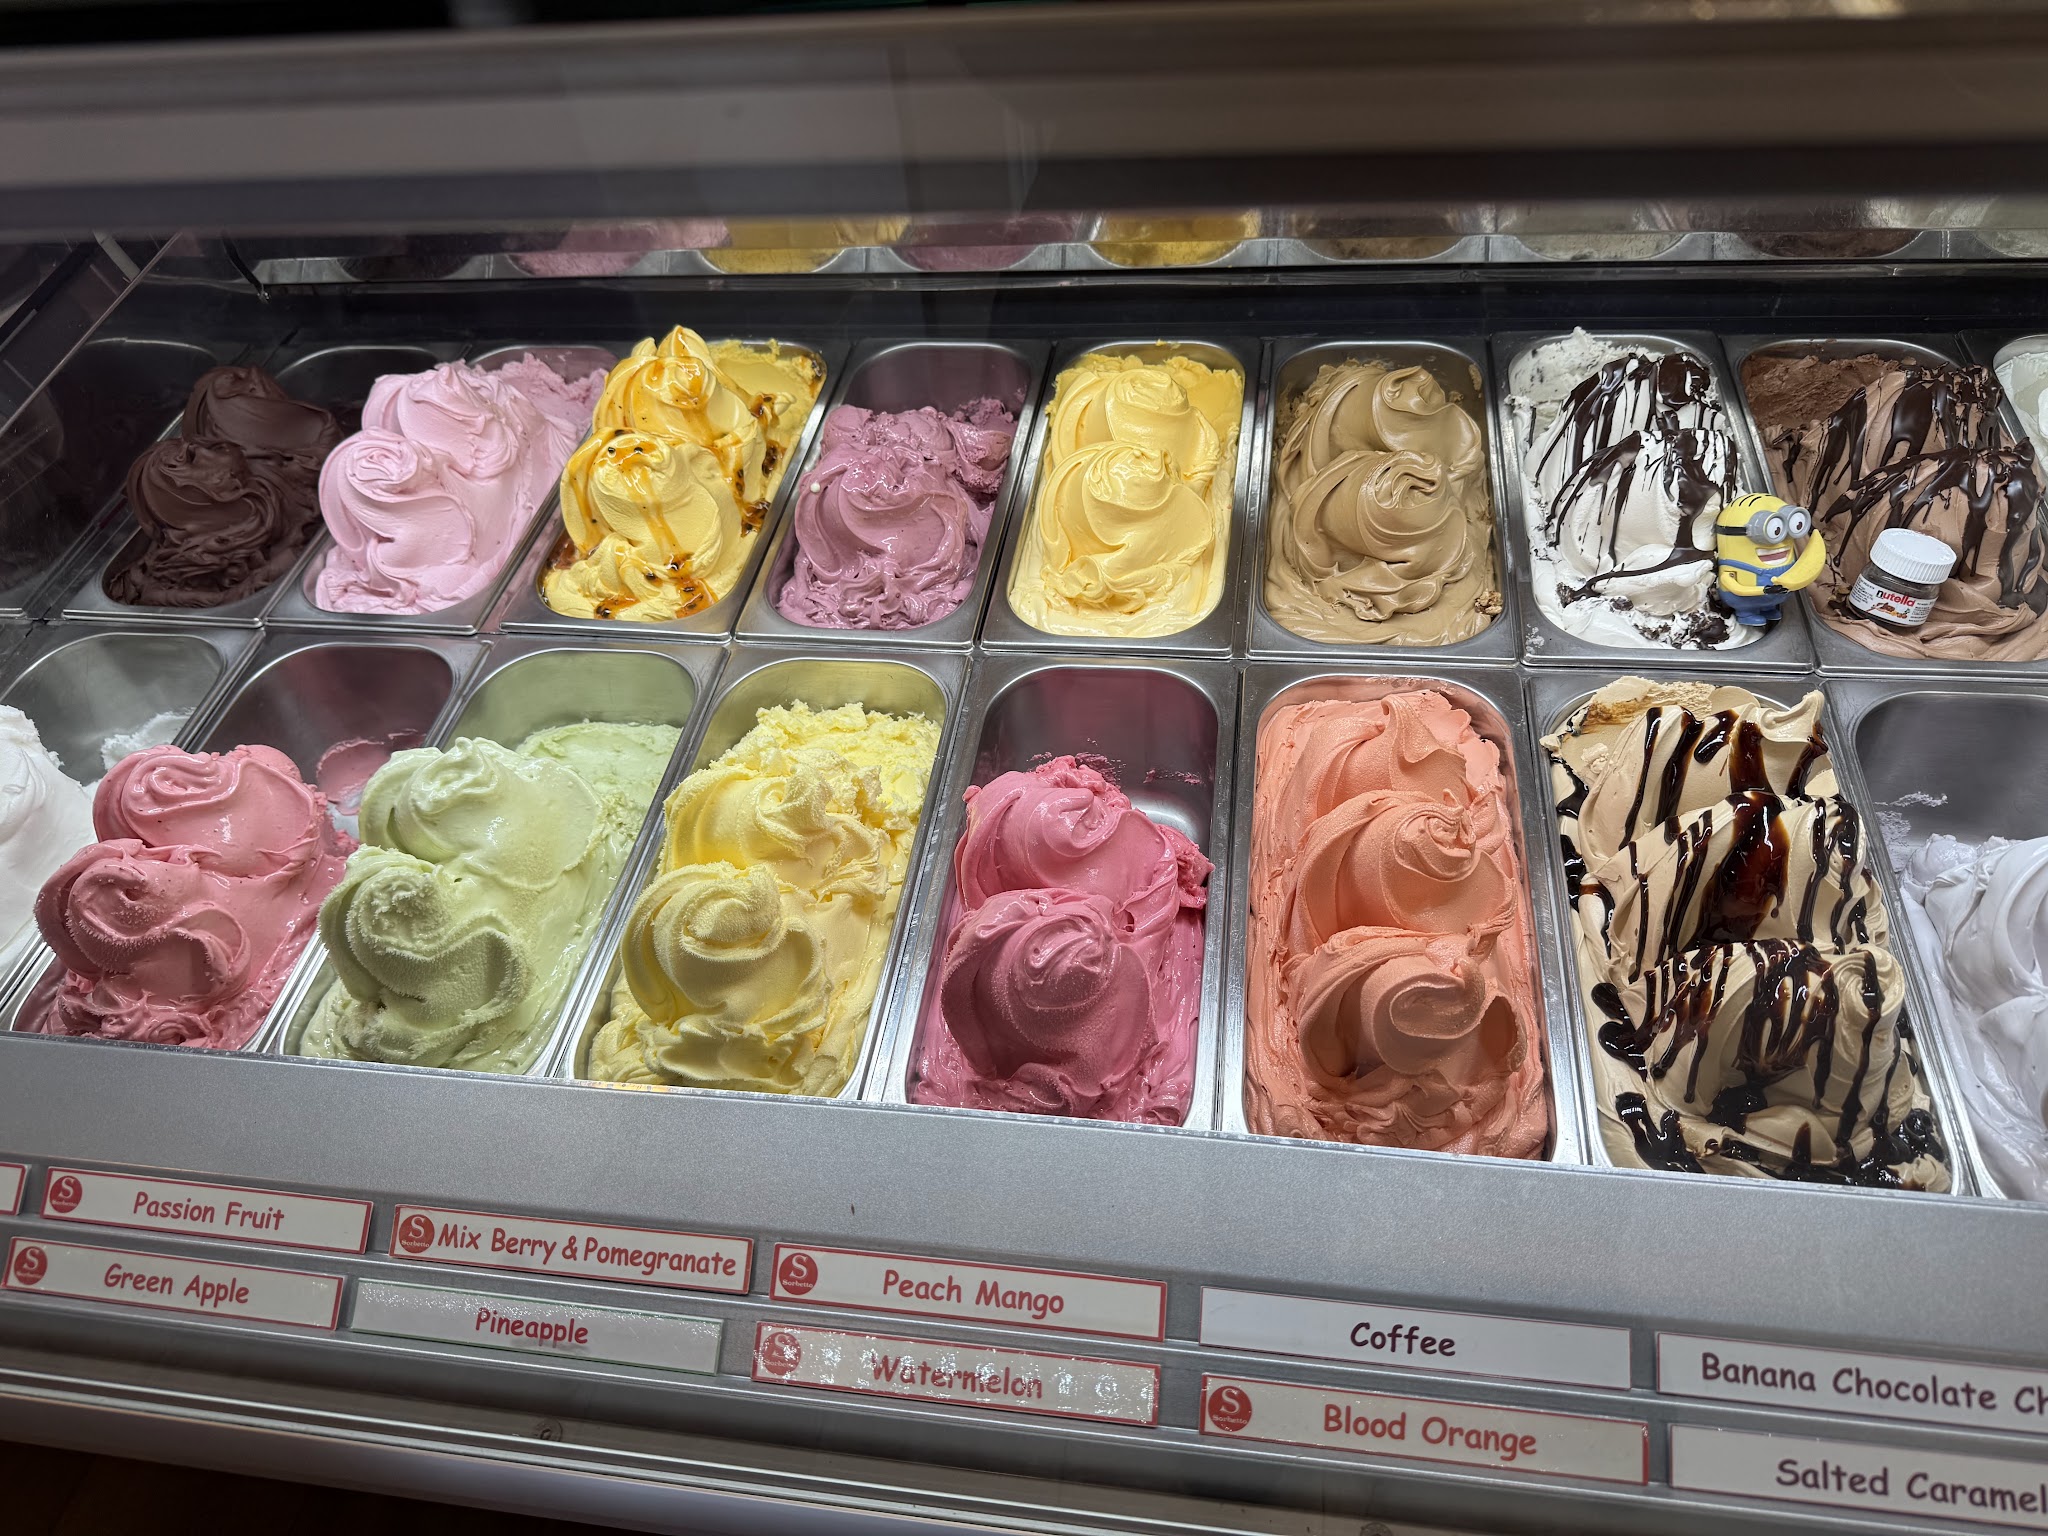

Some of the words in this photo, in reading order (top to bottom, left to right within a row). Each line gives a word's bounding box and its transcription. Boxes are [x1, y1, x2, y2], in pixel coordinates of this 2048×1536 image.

[1876, 589, 1917, 608] nutella
[58, 1177, 75, 1199] S
[133, 1191, 215, 1224] Passion
[224, 1201, 285, 1231] Fruit
[408, 1216, 425, 1239] S
[23, 1248, 40, 1270] S
[401, 1240, 430, 1248] Sorbetto
[437, 1223, 480, 1250] Mix
[491, 1227, 558, 1265] Berry
[561, 1235, 578, 1262] &
[583, 1236, 737, 1277] Pomegranate
[782, 1279, 814, 1288] Sorbetto
[789, 1254, 807, 1279] S
[104, 1263, 173, 1295] Green
[183, 1274, 250, 1308] Apple
[882, 1269, 962, 1304] Peach
[975, 1279, 1065, 1320] Mango
[475, 1307, 589, 1347] Pineapple
[1350, 1322, 1456, 1357] Coffee
[871, 1353, 1043, 1399] Watermelon
[1701, 1352, 1816, 1392] Banana
[1833, 1367, 1997, 1411] Chocolate
[1219, 1387, 1240, 1414] S
[1323, 1403, 1407, 1441] Blood
[1421, 1416, 1537, 1462] Orange
[1775, 1458, 1889, 1497] Salted
[1907, 1472, 2048, 1514] Caramel
